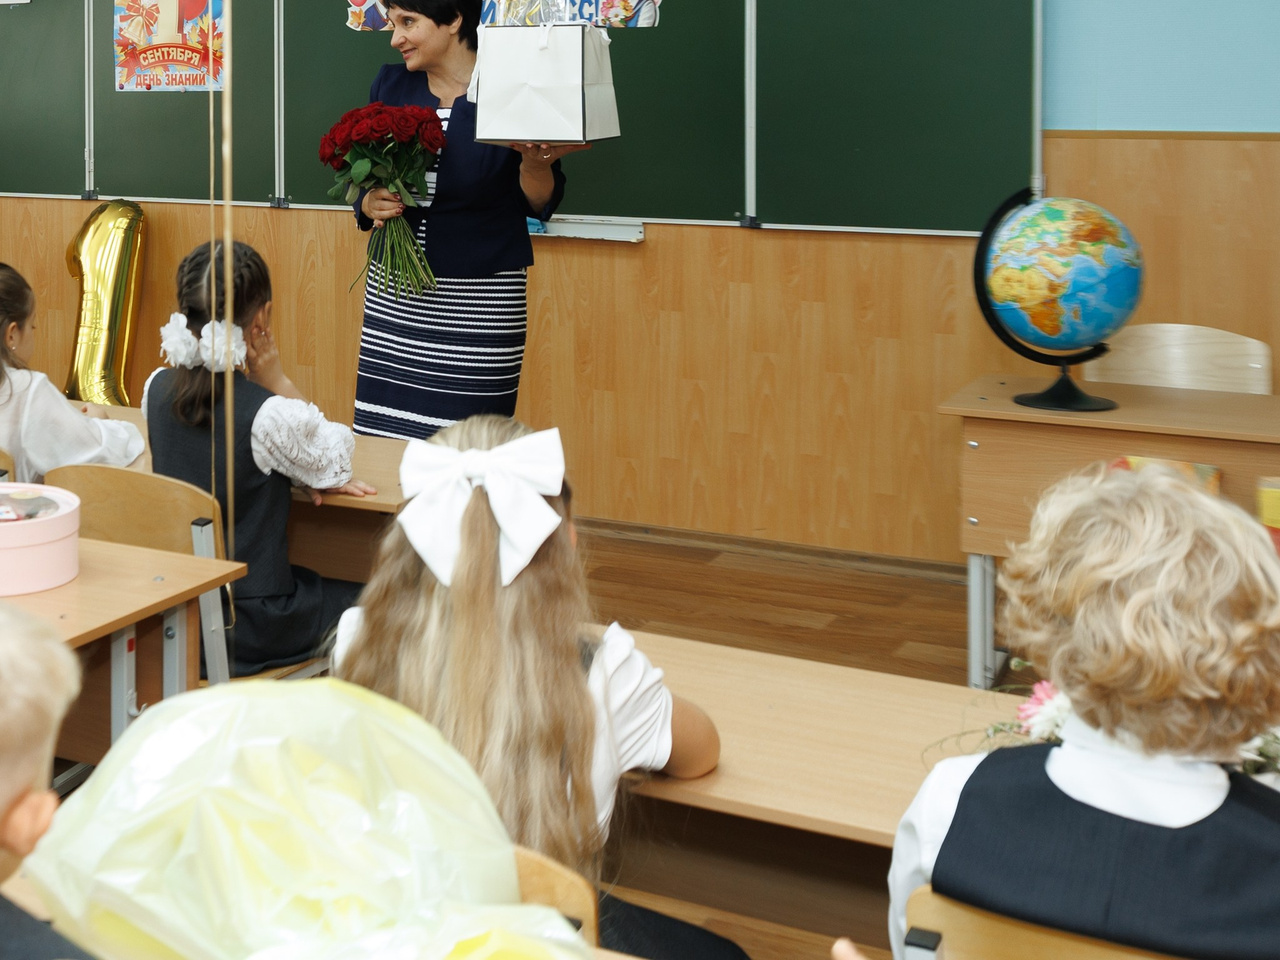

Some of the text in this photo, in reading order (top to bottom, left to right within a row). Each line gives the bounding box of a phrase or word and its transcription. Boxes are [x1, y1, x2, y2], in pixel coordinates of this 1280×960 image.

[140, 47, 200, 65] СЕНТЯБРЯ
[135, 70, 206, 88] ДЕНЬ ЗНАНИЙ
